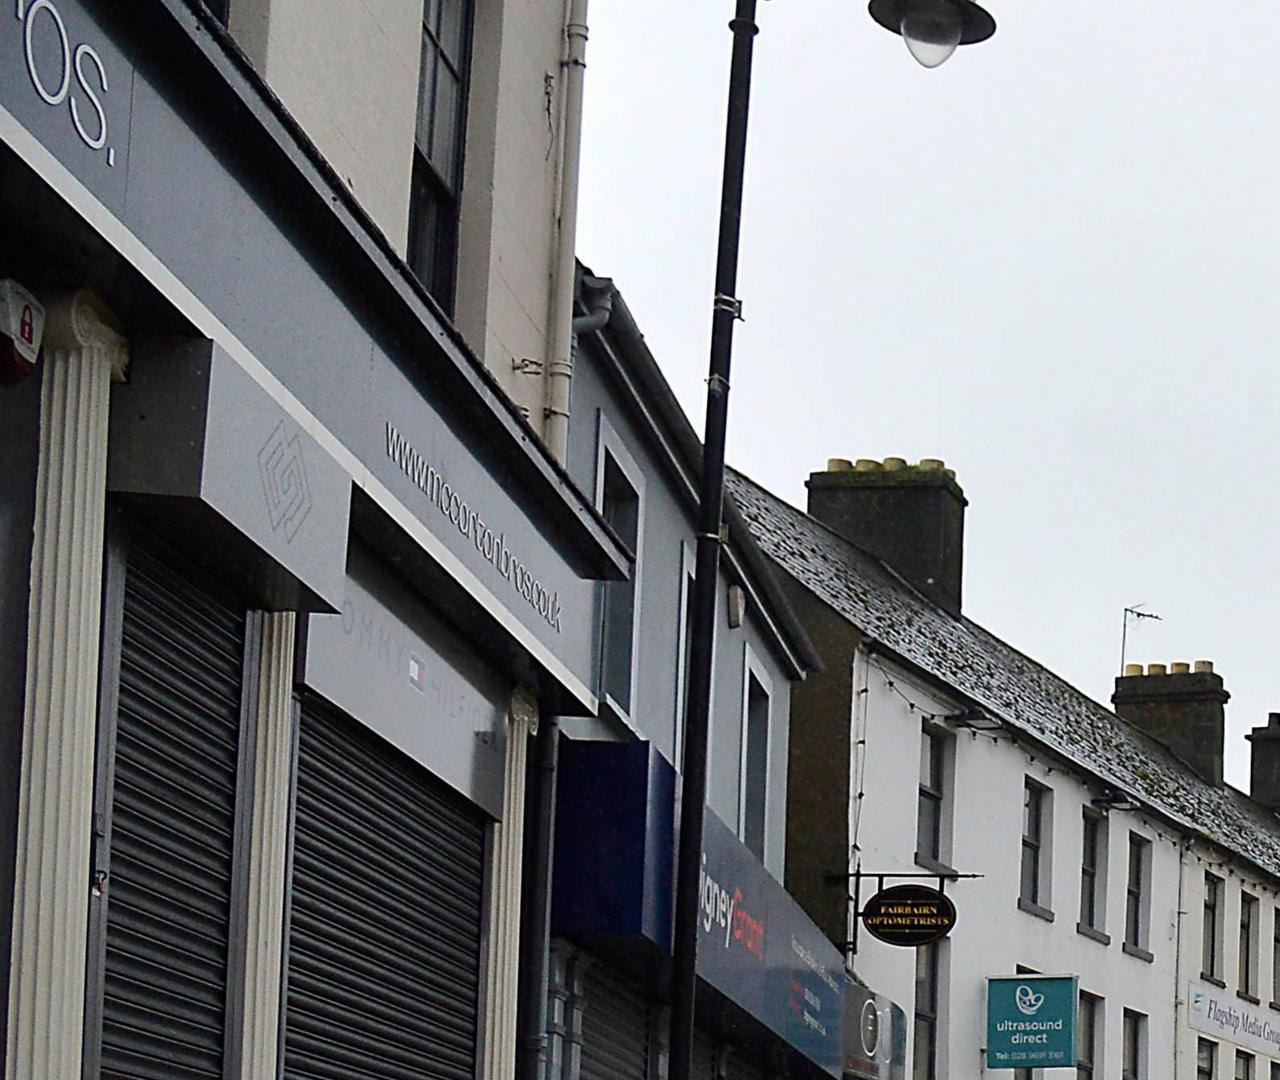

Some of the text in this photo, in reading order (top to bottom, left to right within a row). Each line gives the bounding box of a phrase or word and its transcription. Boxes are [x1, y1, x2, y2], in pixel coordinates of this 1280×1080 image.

[17, 0, 115, 167] OS.
[880, 905, 938, 915] FAIRBAIRN
[867, 916, 950, 926] OPTOMETRISTS
[1207, 999, 1240, 1035] Flagship
[1241, 1012, 1263, 1038] Media
[996, 1019, 1063, 1032] ultrasound
[1011, 1033, 1048, 1044] direct
